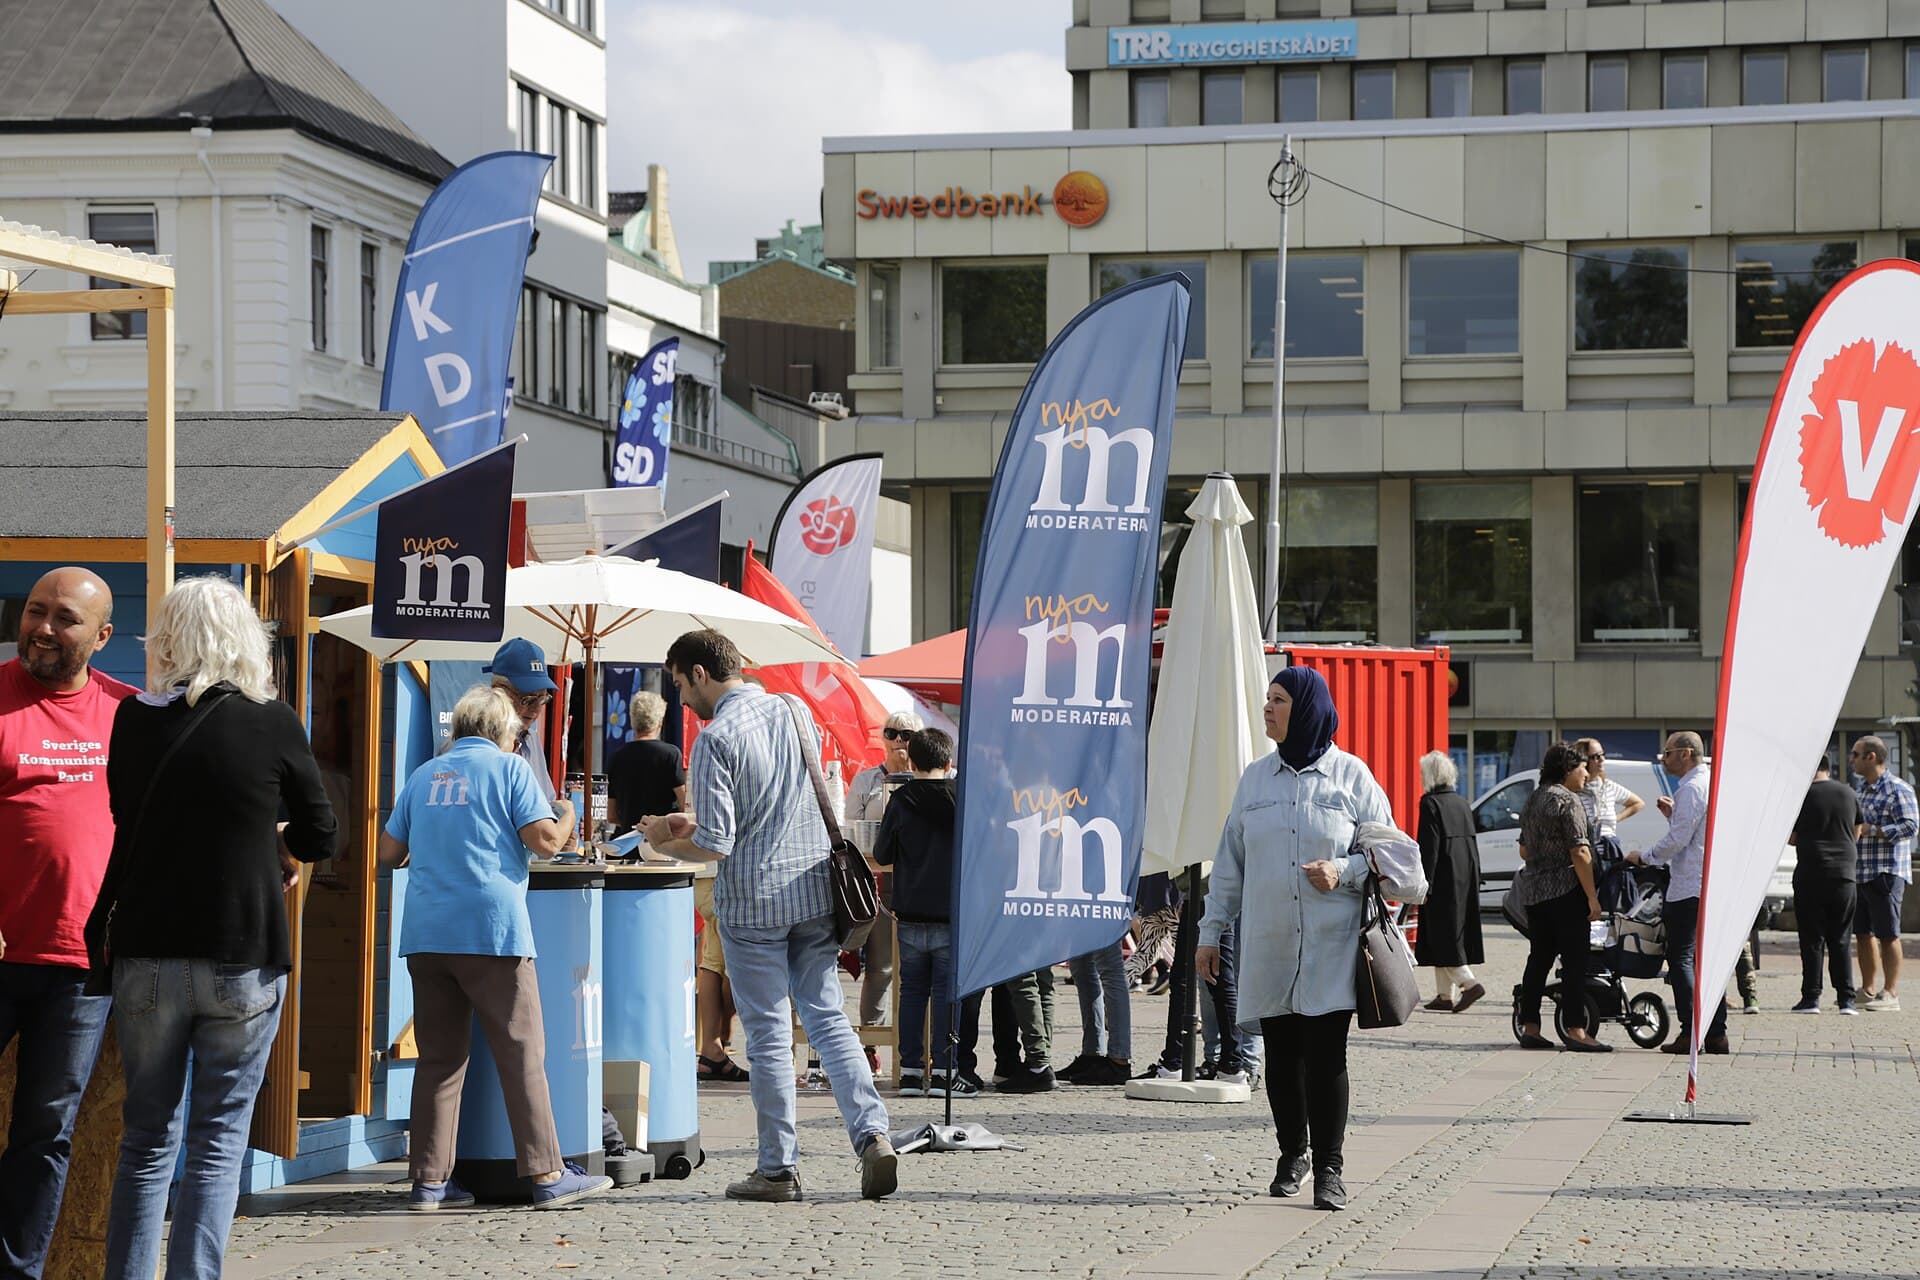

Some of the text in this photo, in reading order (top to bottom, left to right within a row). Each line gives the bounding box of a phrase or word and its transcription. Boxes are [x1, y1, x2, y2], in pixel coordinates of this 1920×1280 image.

[1112, 30, 1352, 61] TRR TRYGGHETSRÅDET
[857, 184, 1043, 220] Swedbank
[1041, 398, 1121, 450] nya
[614, 442, 655, 484] SD
[1030, 424, 1154, 513] m
[1837, 399, 1907, 502] V
[403, 536, 459, 568] nya
[397, 551, 491, 608] m
[396, 606, 490, 620] MODERATERNA
[1025, 593, 1109, 644] nya
[1012, 617, 1133, 709] m
[18, 753, 108, 766] Kommunisti
[42, 739, 102, 753] Sveriges
[58, 771, 94, 783] Parti
[425, 777, 469, 806] m
[1012, 787, 1089, 838] nya
[1005, 811, 1132, 902] m
[1003, 901, 1132, 921] MODERATERNA
